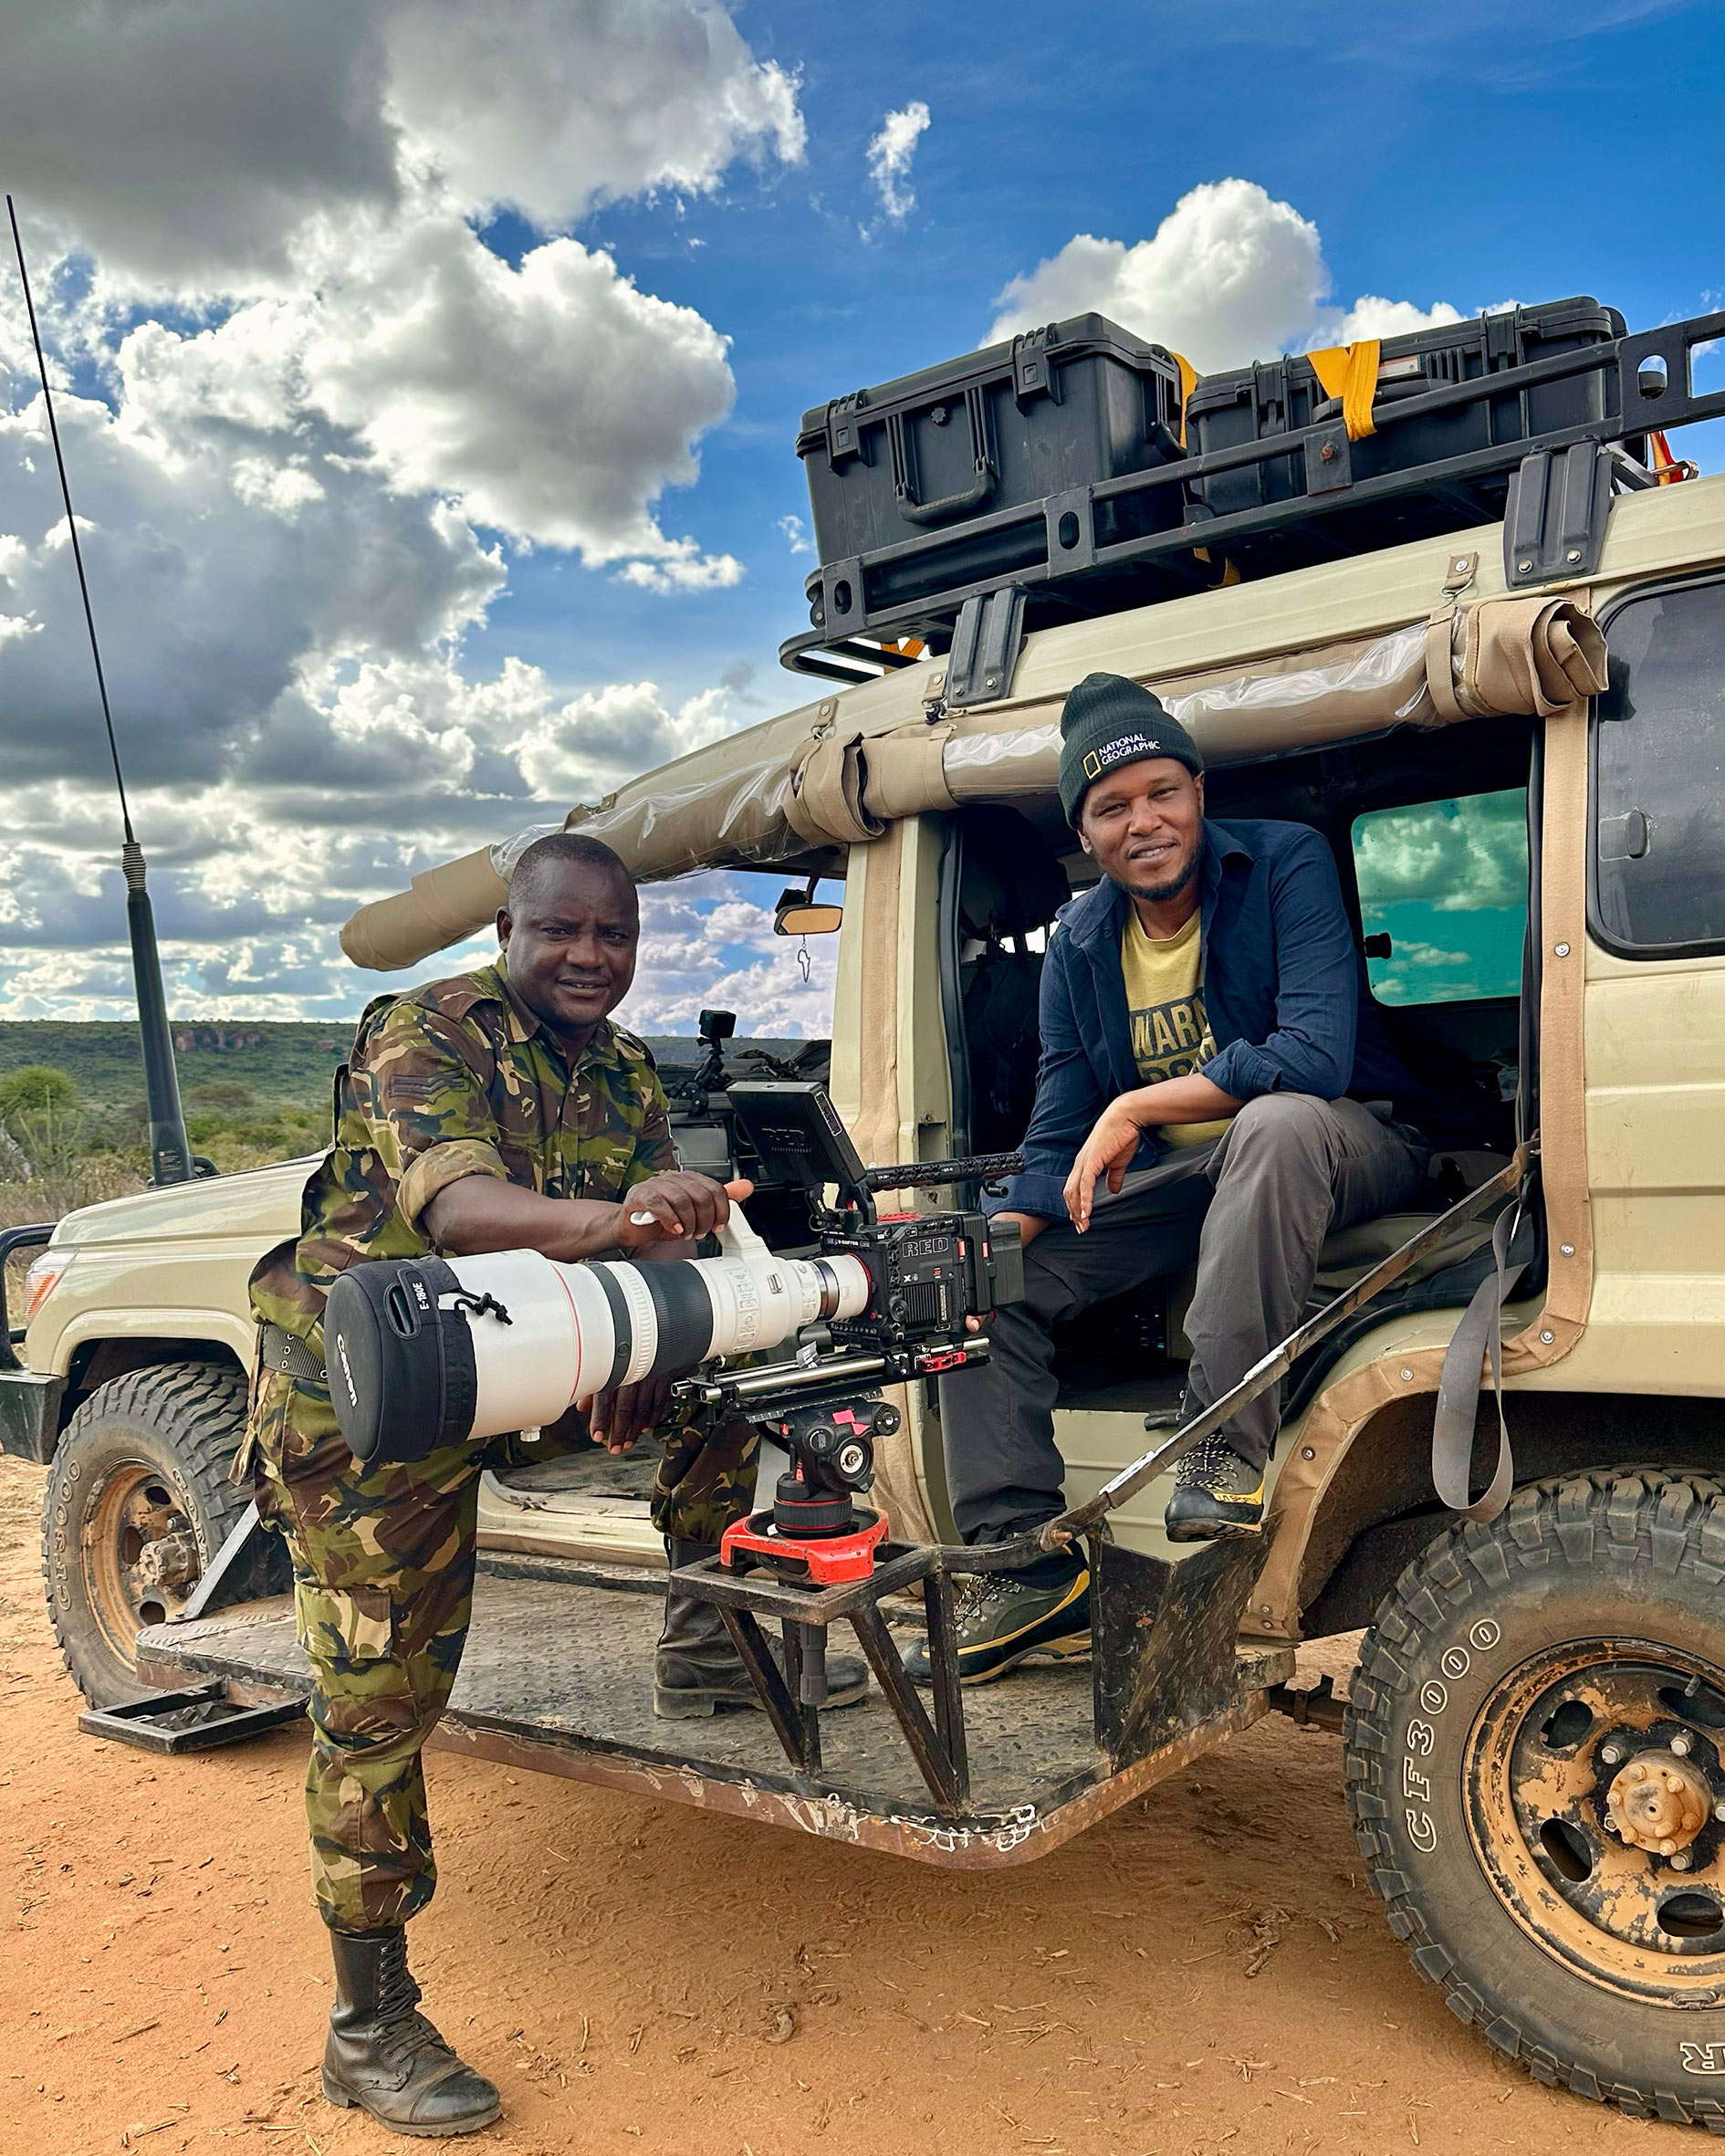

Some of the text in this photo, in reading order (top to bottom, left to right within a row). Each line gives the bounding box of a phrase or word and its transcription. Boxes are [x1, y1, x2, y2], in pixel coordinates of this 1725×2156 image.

[1098, 733, 1146, 757] NATIONAL
[1102, 740, 1161, 765] GEOGRAPHIC
[902, 1237, 949, 1258] RED
[413, 1282, 430, 1310] E-180E
[336, 1333, 358, 1408] Canon
[53, 1460, 80, 1611] CF3000
[1403, 1618, 1500, 1853] CF3000
